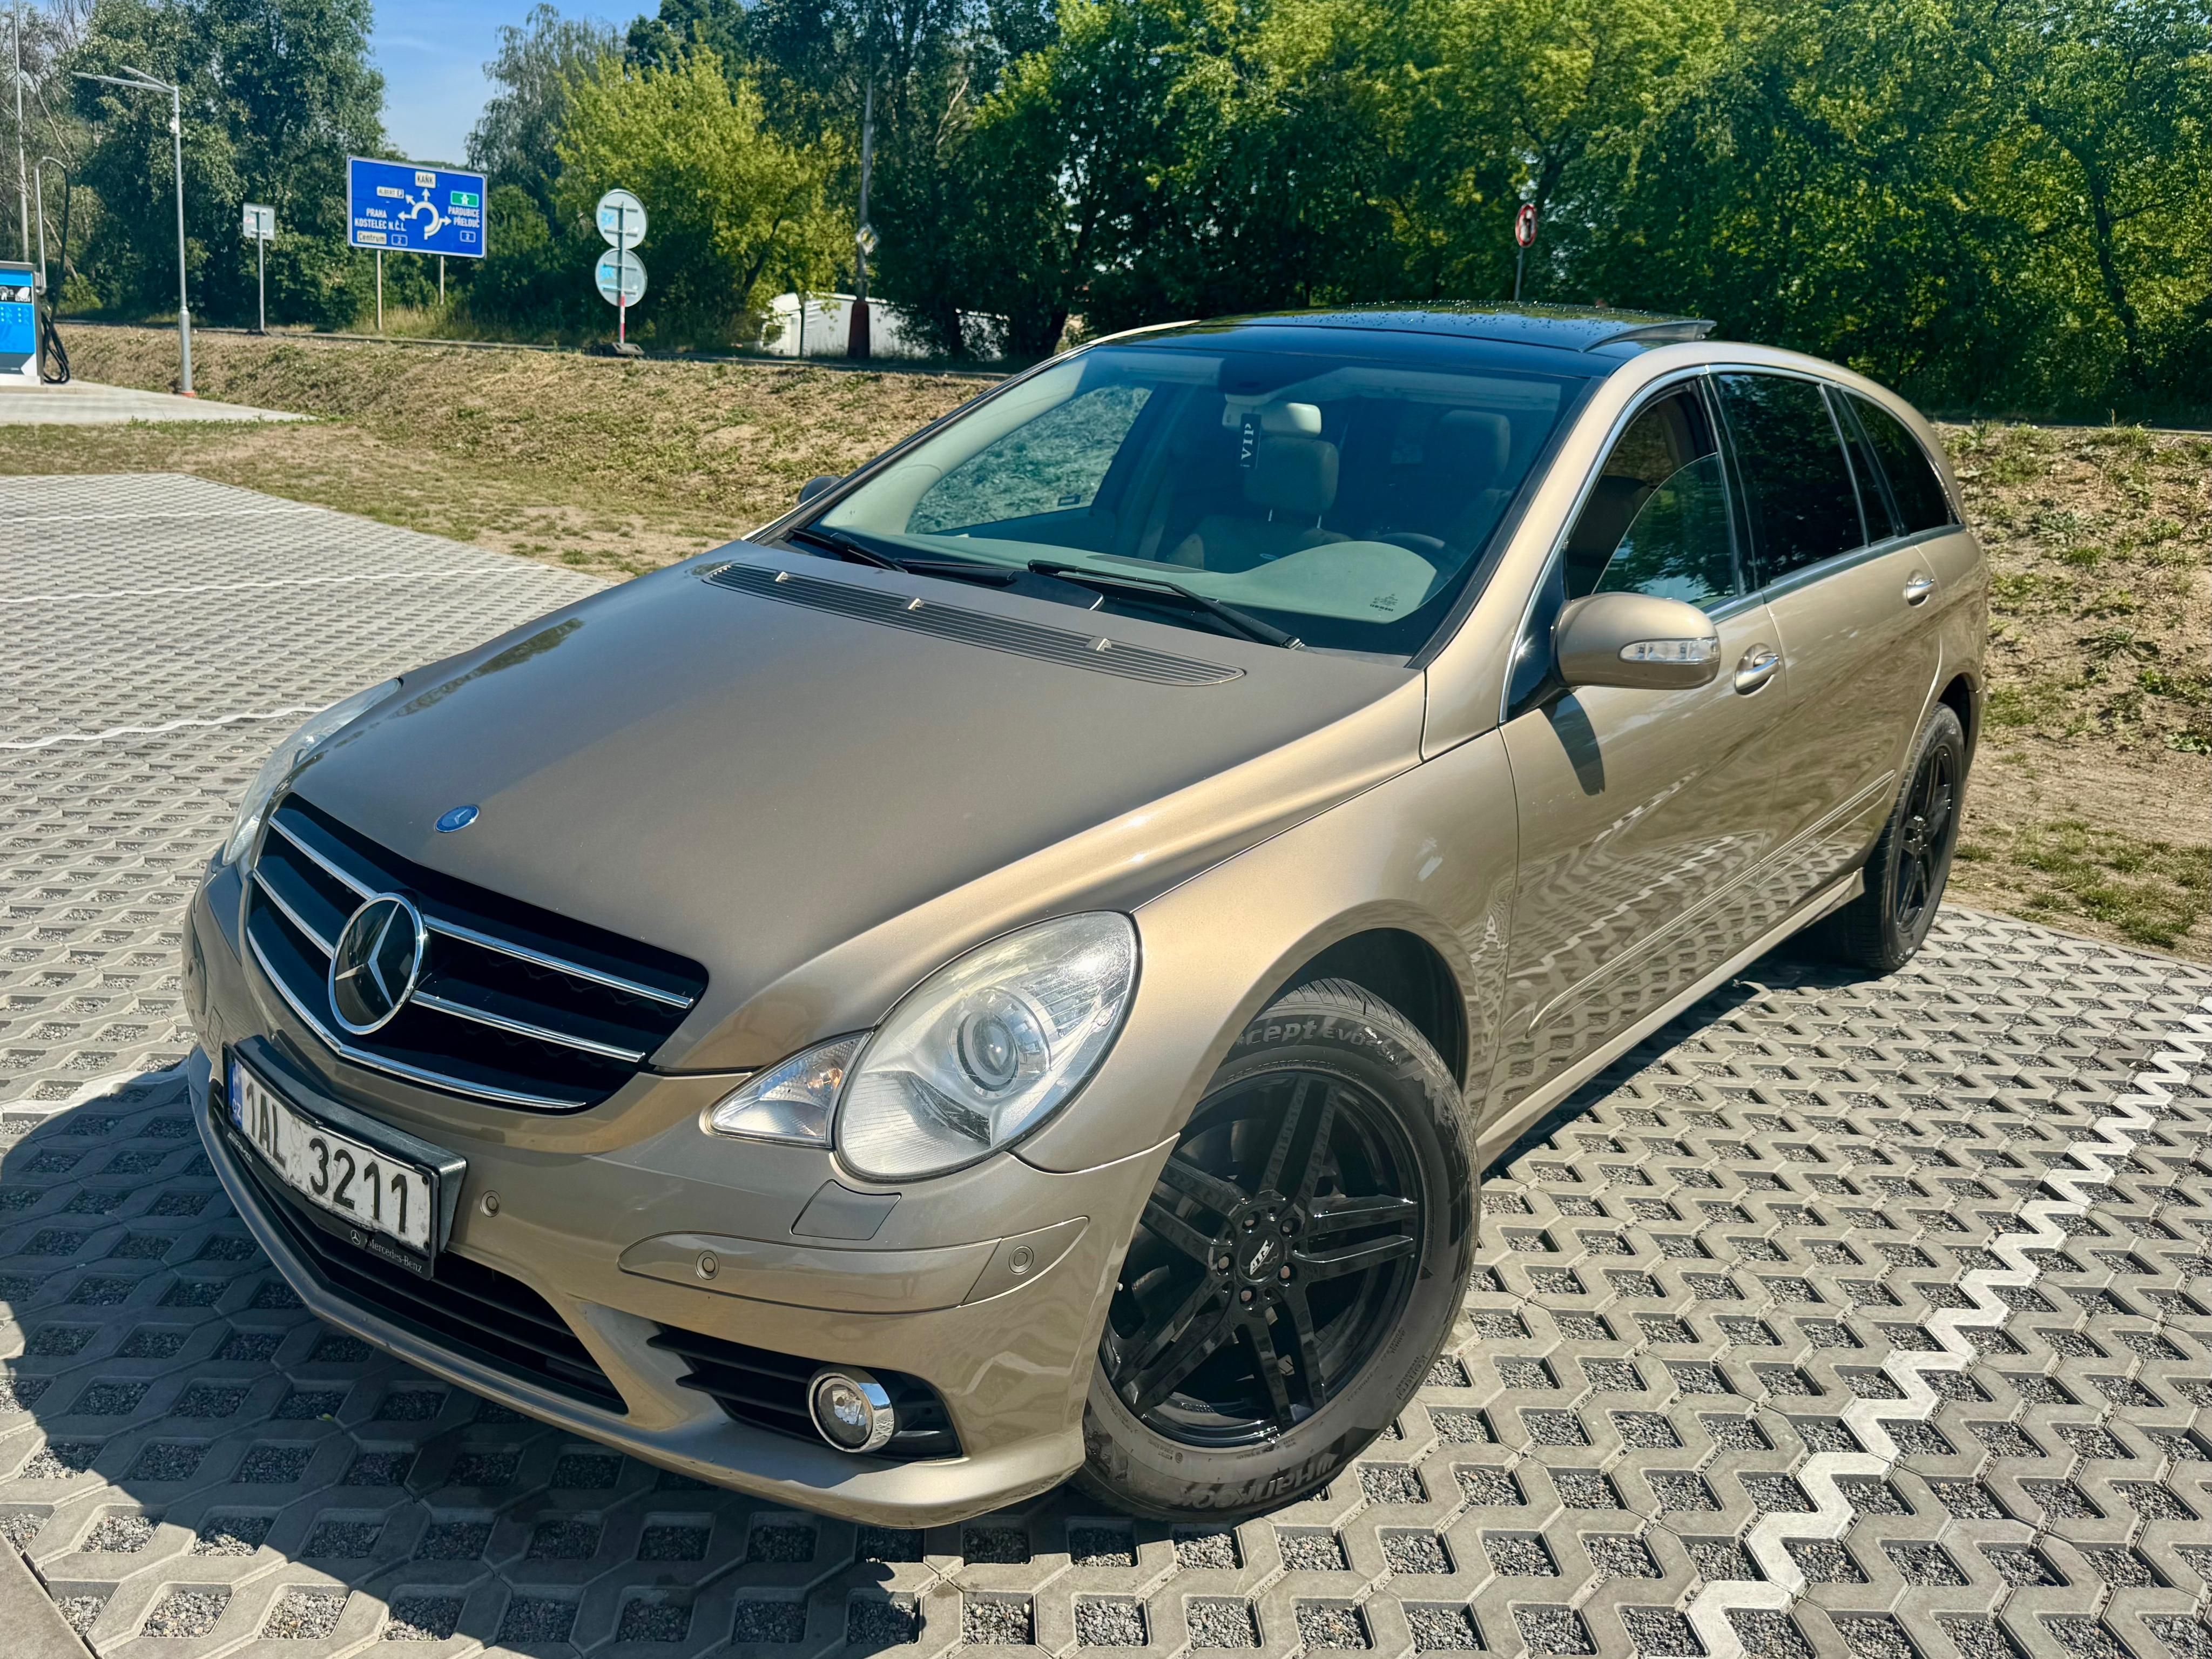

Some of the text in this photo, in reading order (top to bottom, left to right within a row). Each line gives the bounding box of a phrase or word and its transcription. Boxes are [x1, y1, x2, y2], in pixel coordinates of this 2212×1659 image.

[366, 208, 387, 218] PRAHA
[448, 206, 480, 218] PARDUBICE
[354, 218, 387, 230] KOSTELEC
[359, 233, 386, 243] Centrum
[1241, 423, 1253, 460] VIP
[232, 1097, 241, 1120] CZ
[246, 1082, 408, 1233] 1AL 3211
[366, 1238, 422, 1273] Mercedes-Benz
